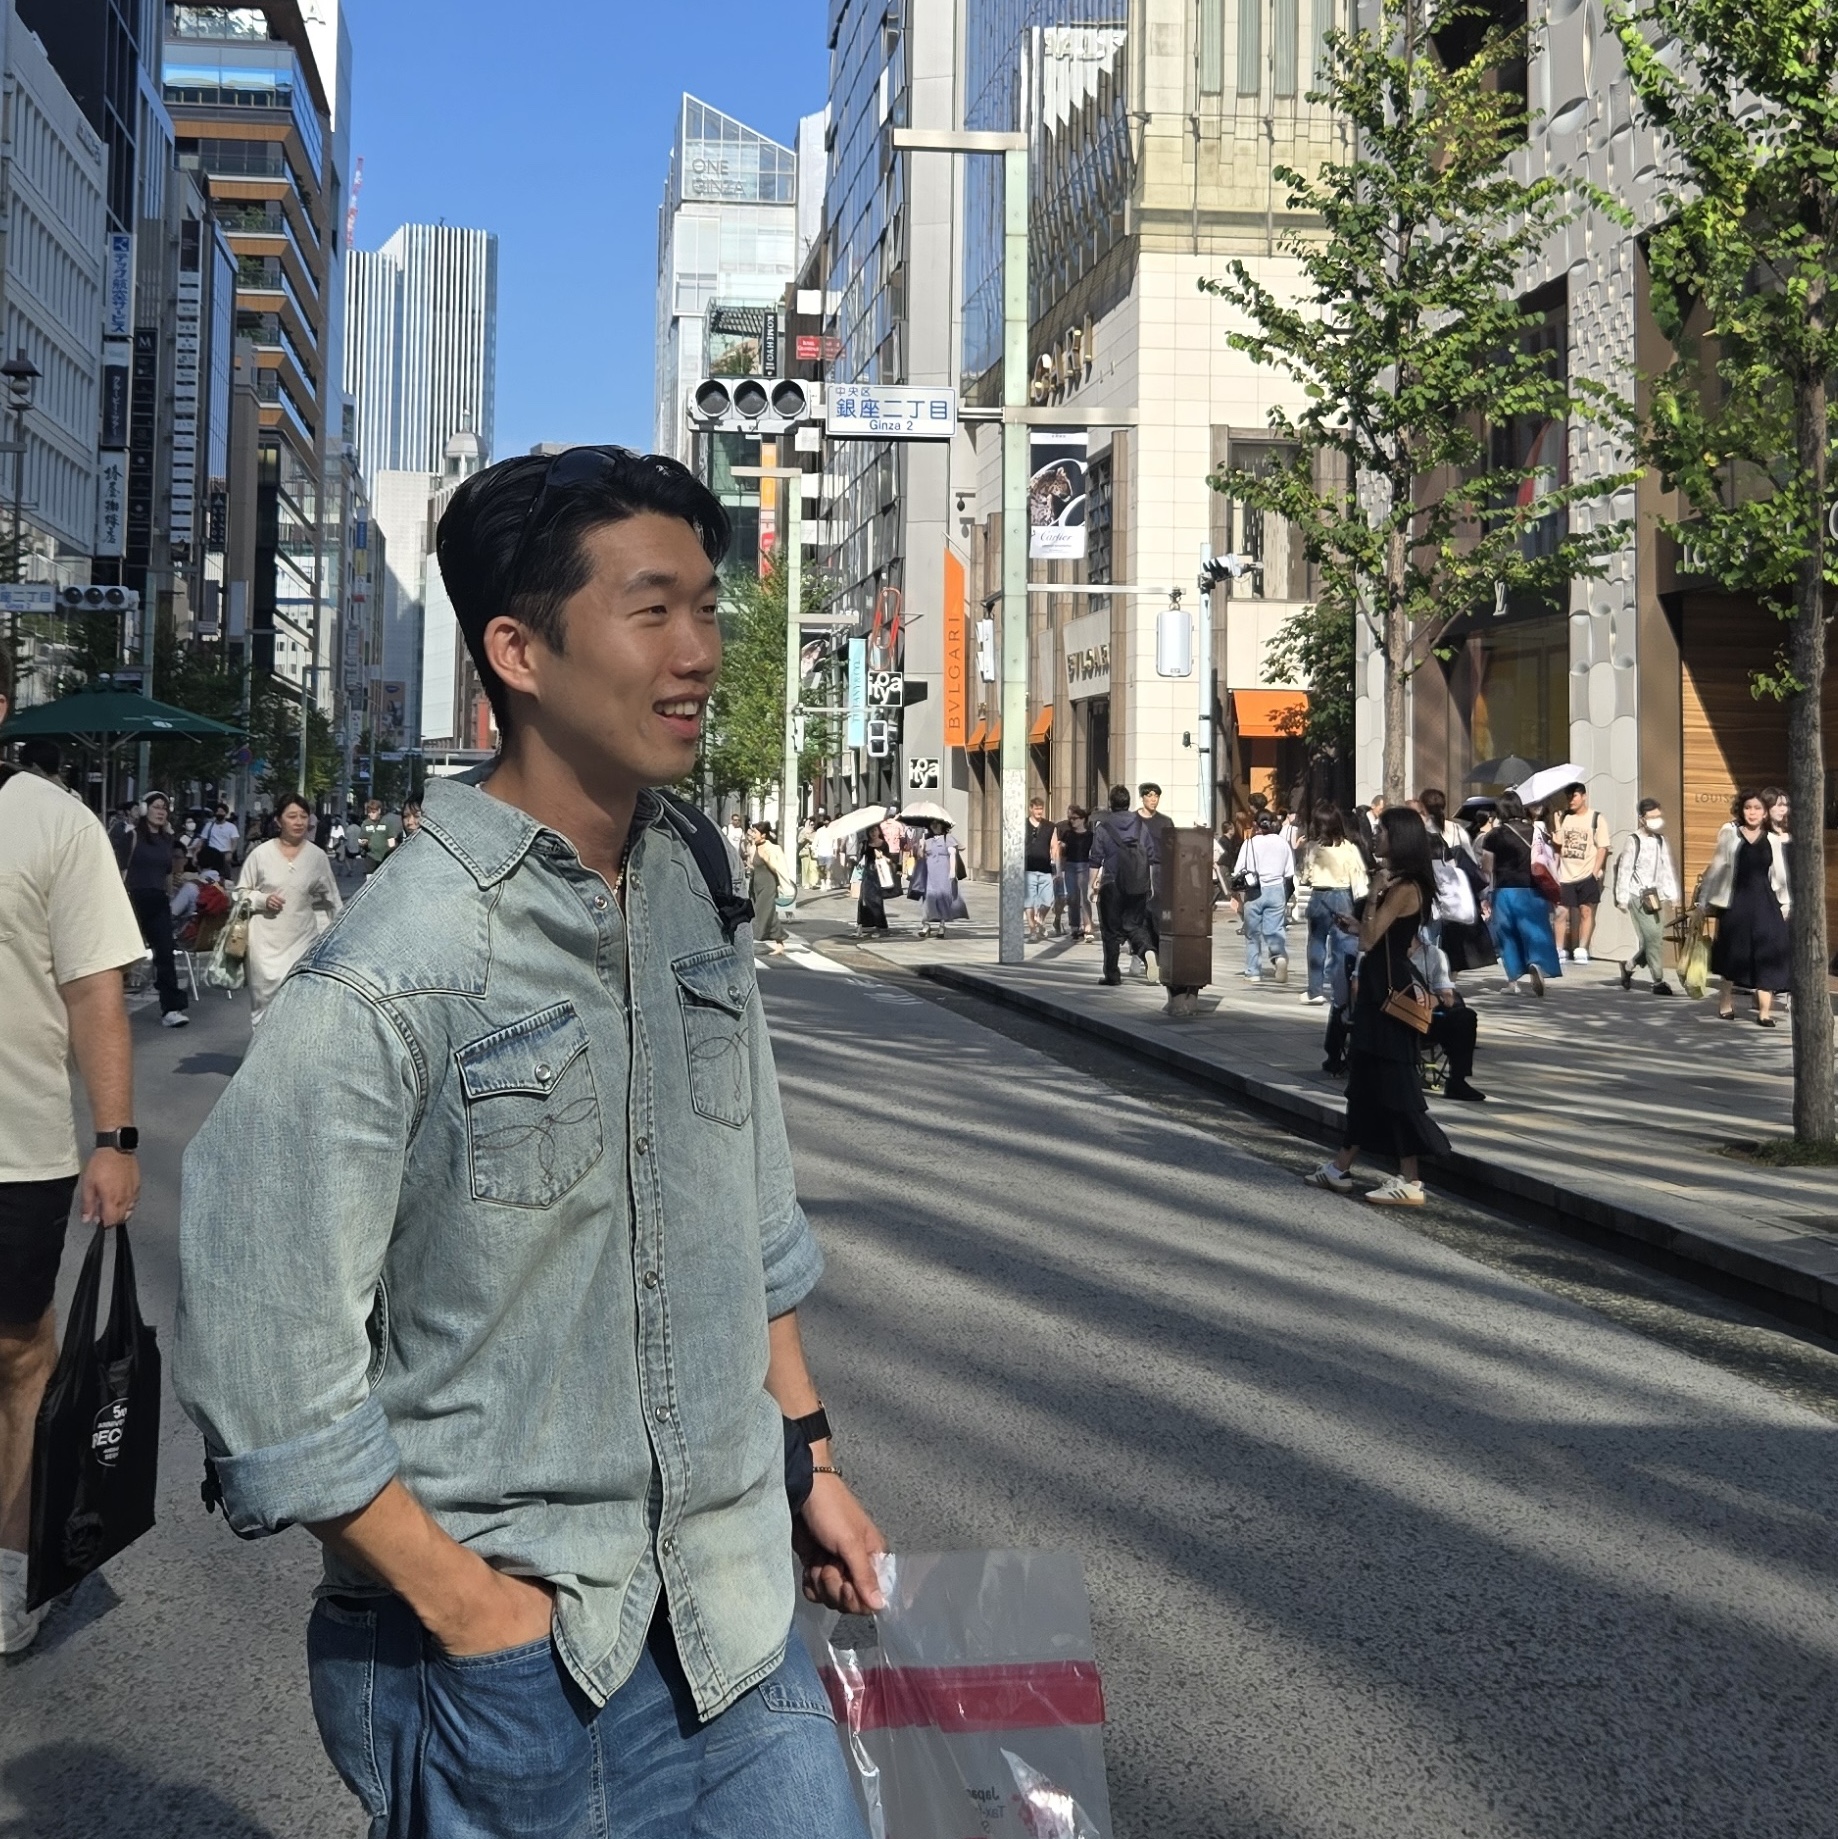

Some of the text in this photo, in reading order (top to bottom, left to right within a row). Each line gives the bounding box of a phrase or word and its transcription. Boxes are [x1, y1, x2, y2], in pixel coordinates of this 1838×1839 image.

[692, 158, 729, 175] ONE
[692, 178, 746, 196] GINZA
[836, 387, 870, 396] 中央区
[836, 398, 948, 420] 銀座二丁目
[869, 420, 914, 431] Ginza 2
[948, 618, 961, 729] BVLGARI
[1695, 793, 1729, 803] LOUIS
